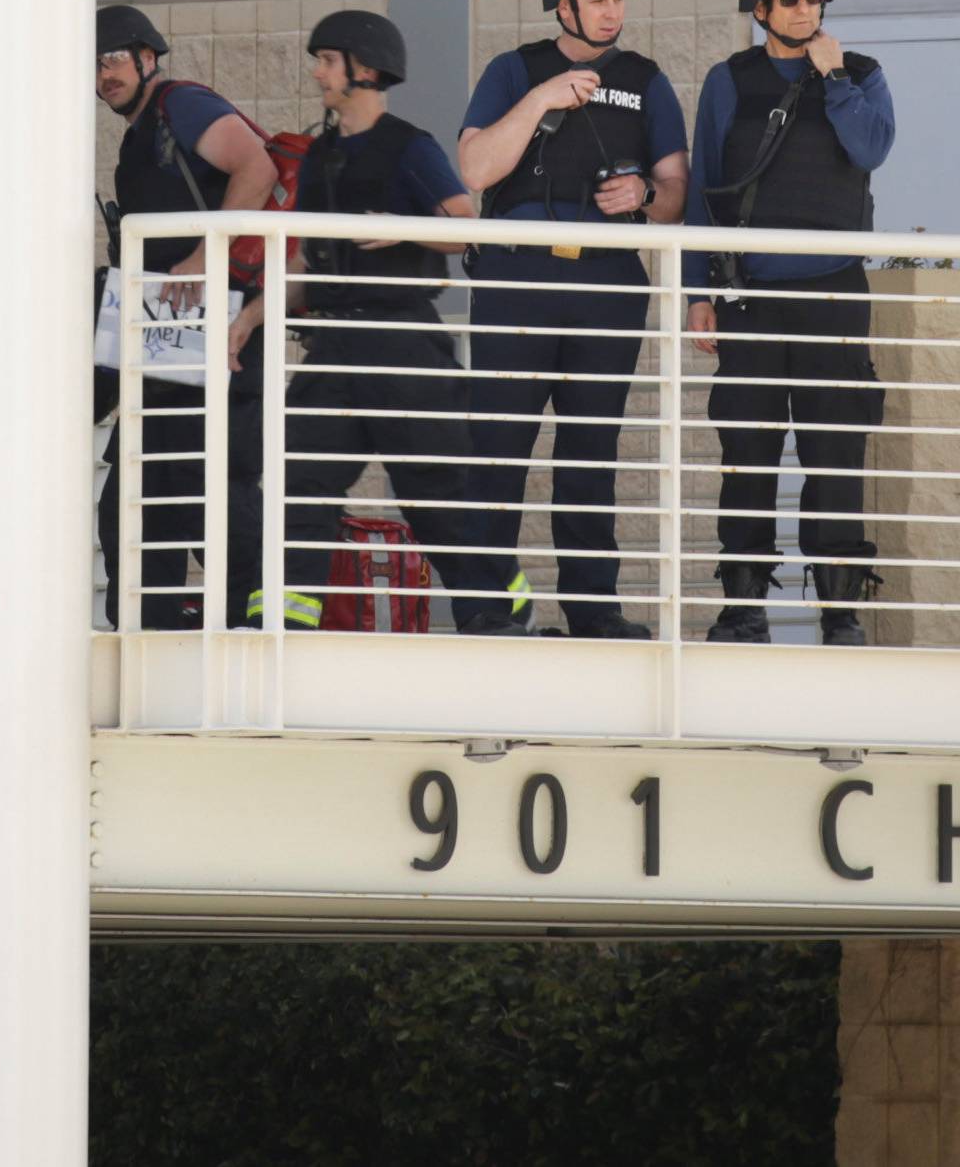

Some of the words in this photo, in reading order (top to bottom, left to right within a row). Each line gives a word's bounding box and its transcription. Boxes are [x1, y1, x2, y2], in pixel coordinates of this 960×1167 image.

[591, 88, 607, 103] SK
[609, 89, 641, 110] FORCE
[409, 770, 660, 877] 901
